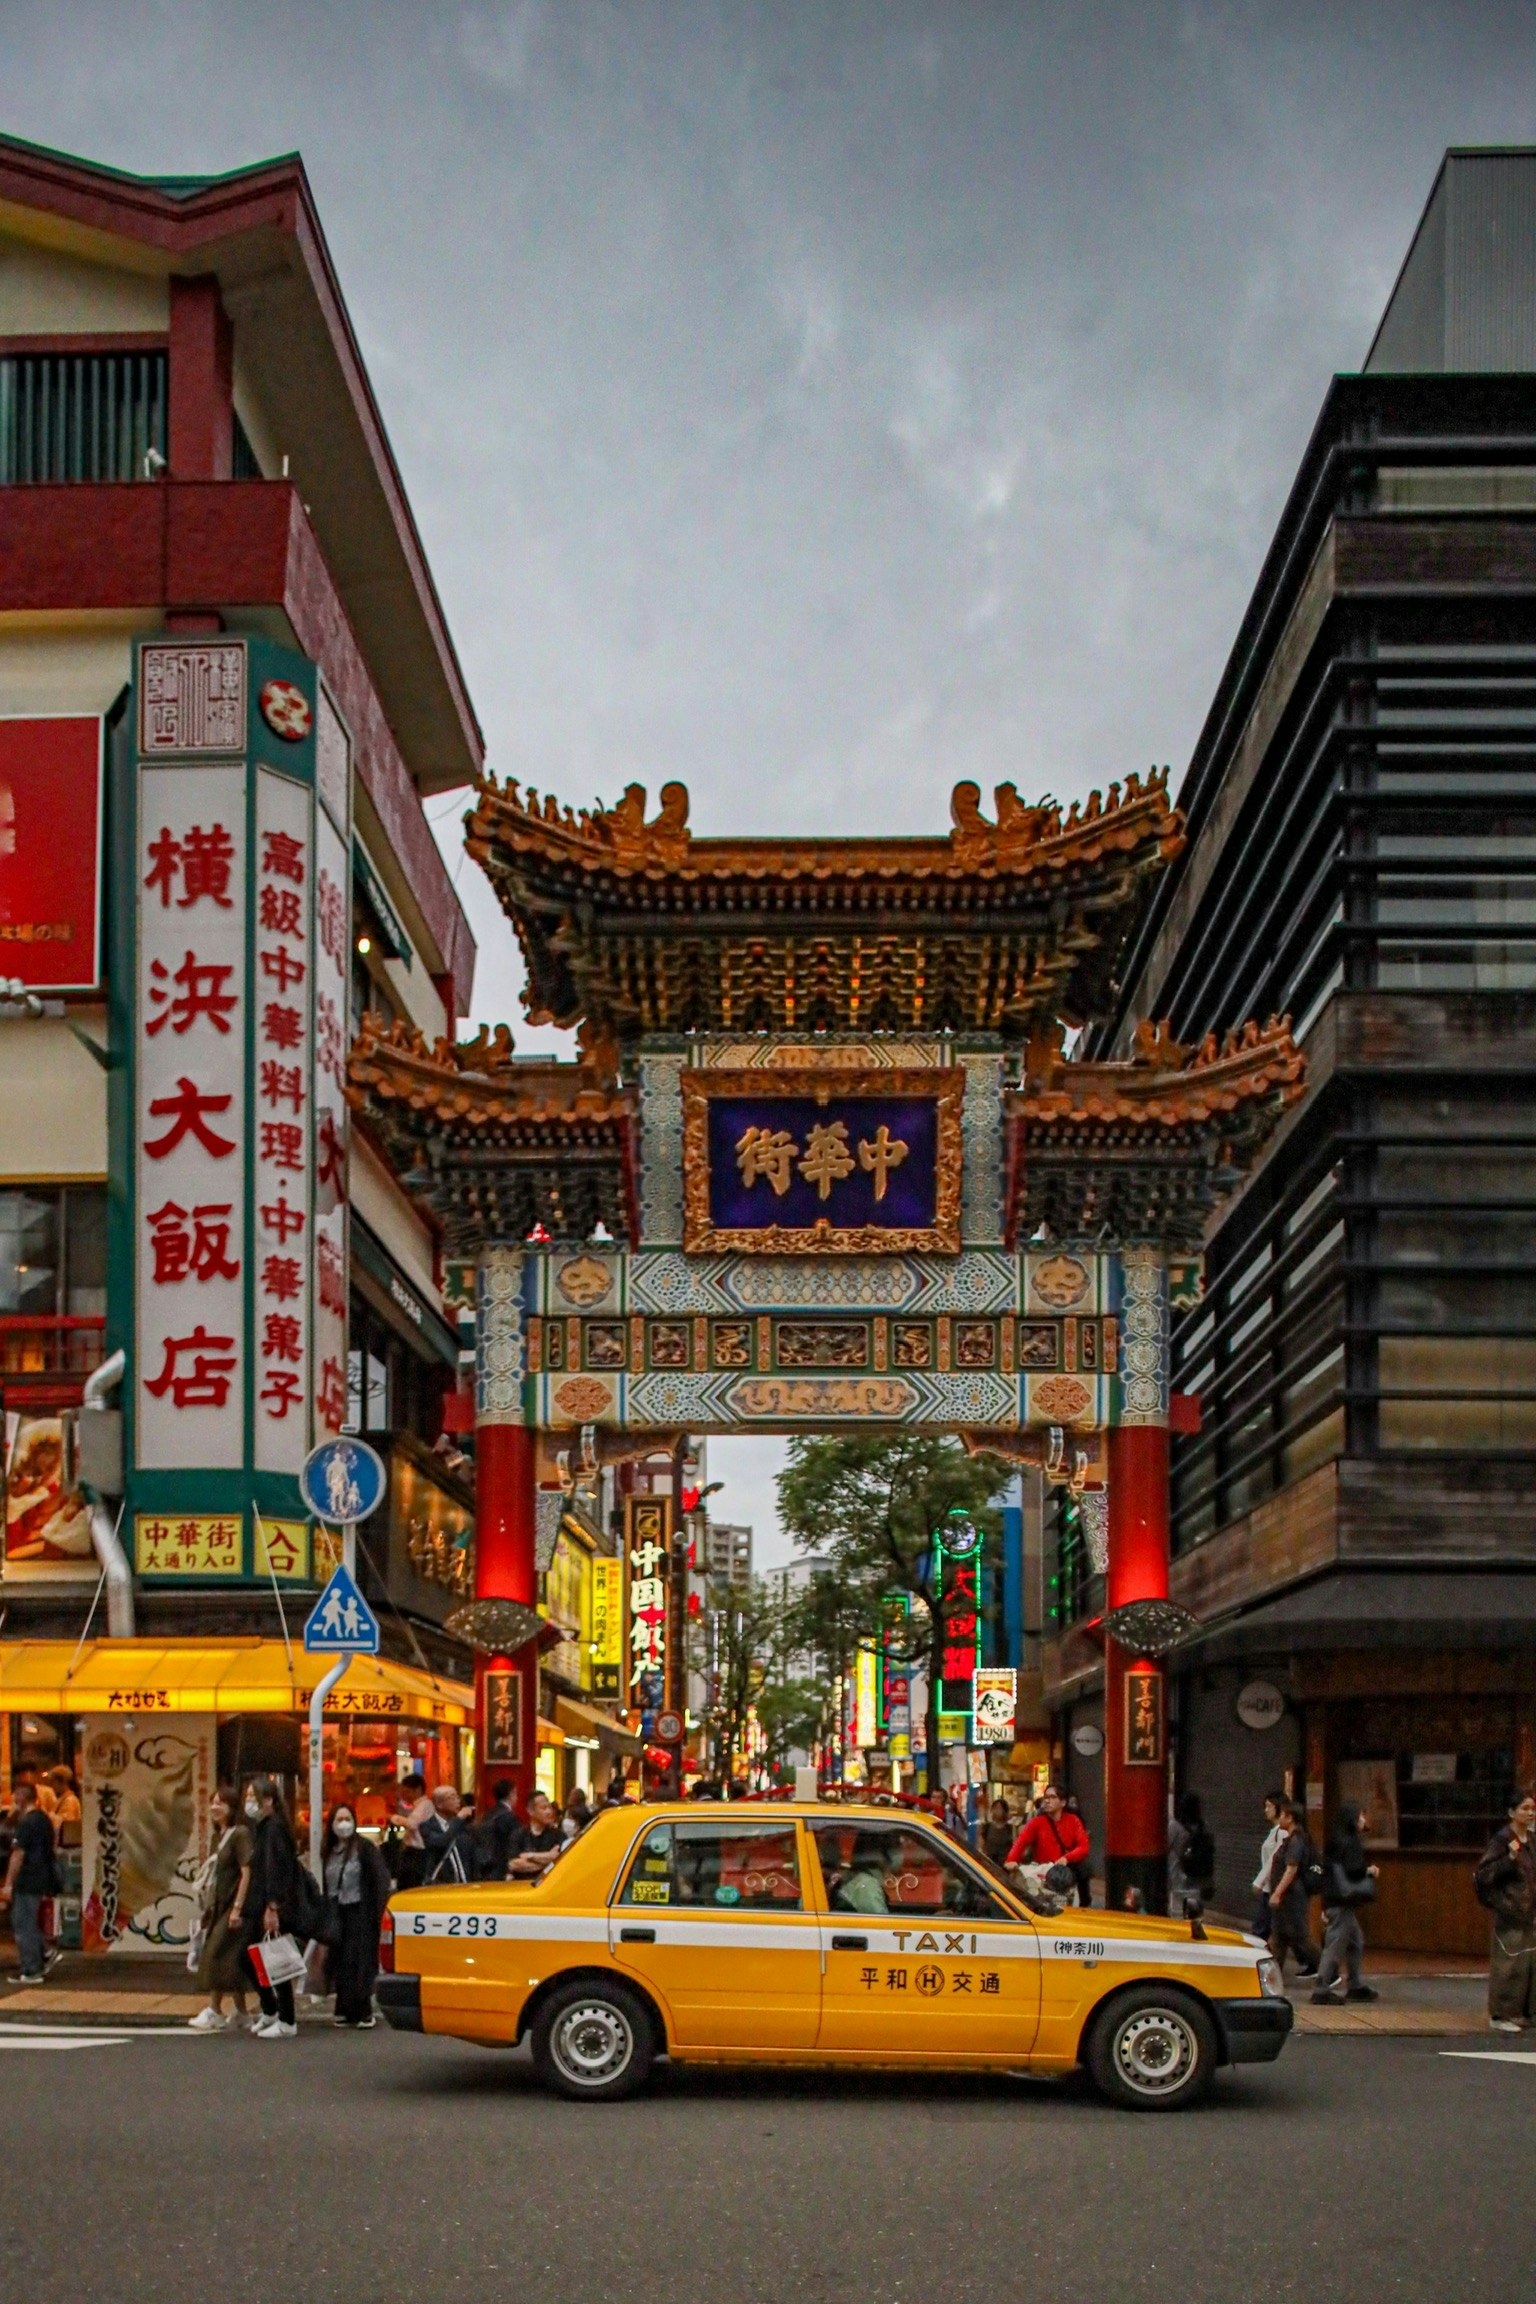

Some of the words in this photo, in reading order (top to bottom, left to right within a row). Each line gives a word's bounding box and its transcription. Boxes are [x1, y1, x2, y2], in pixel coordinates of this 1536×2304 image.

[143, 823, 240, 1409] 横浜大飯店
[143, 1521, 239, 1549] 中華街
[144, 1552, 238, 1570] 大通り入口
[265, 1525, 301, 1573] 入口
[412, 1914, 498, 1937] 5-293
[892, 1931, 977, 1954] TAXI
[1053, 1939, 1105, 1957] (神奈川)
[859, 1966, 908, 1991] 平和
[952, 1970, 1001, 1995] 交通
